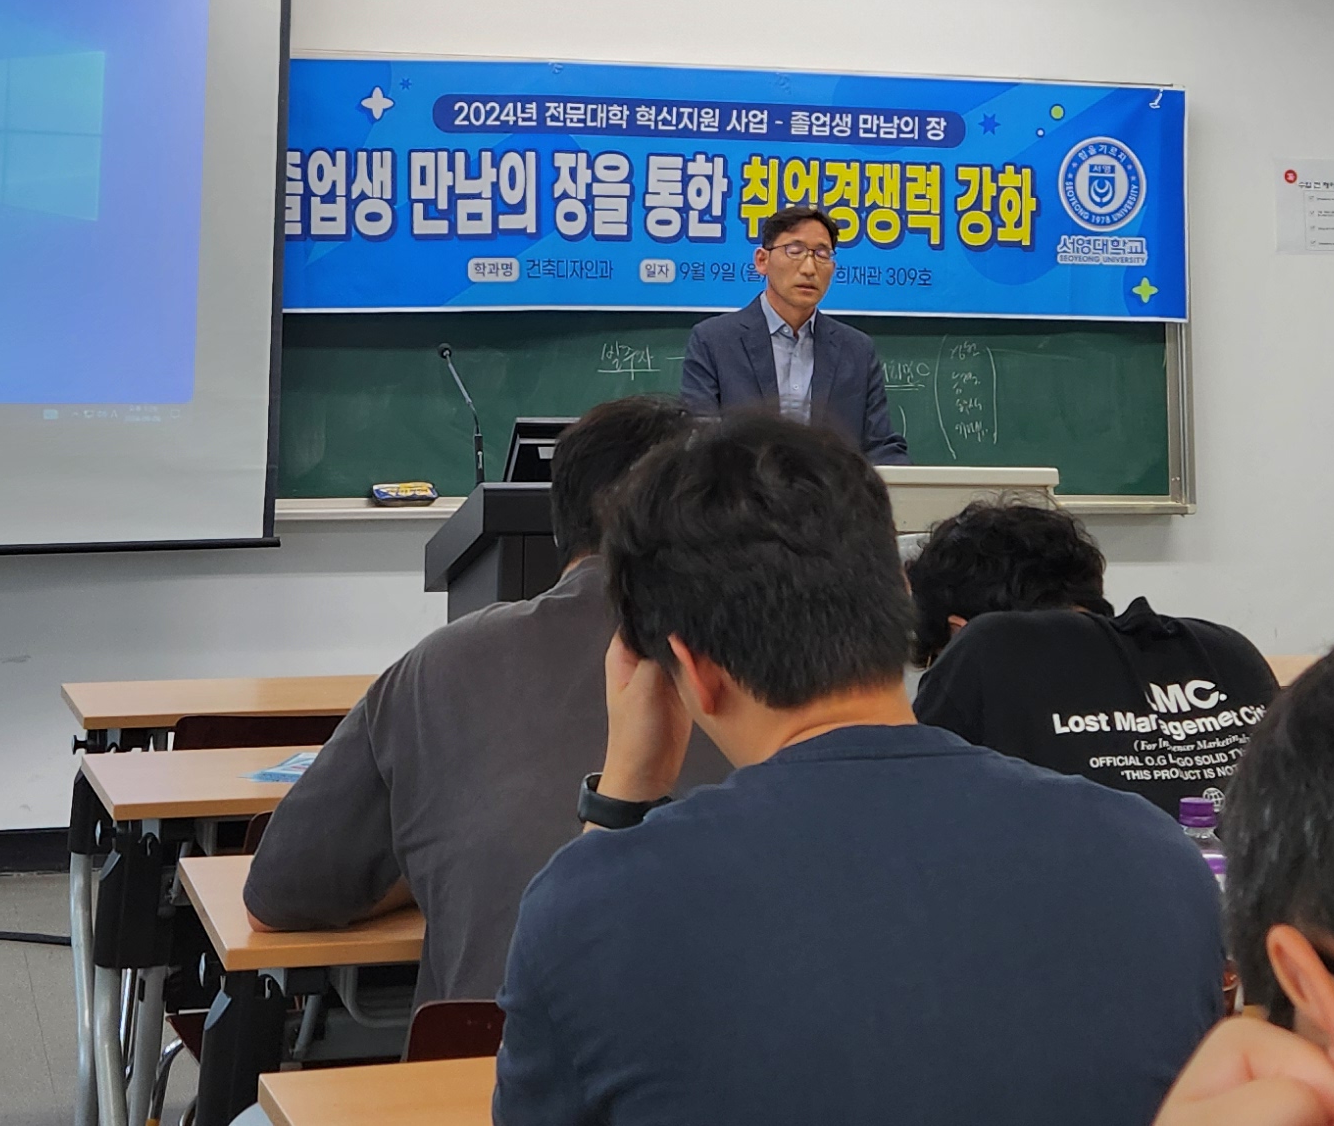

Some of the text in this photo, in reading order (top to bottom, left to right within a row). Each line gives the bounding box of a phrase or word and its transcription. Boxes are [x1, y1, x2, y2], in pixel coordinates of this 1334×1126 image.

[453, 101, 537, 126] 2024년
[544, 101, 629, 129] 전문대학
[635, 104, 720, 132] 혁신지원
[726, 108, 768, 134] 사업
[790, 110, 852, 137] 졸업생
[858, 113, 919, 140] 만남의
[925, 116, 947, 141] 장
[410, 150, 536, 235] 만남의
[553, 151, 631, 236] 장을
[644, 154, 728, 239] 통한
[957, 164, 1036, 247] 강화
[1059, 237, 1146, 255] 서영대학교
[526, 259, 614, 280] 건축디자인과
[1059, 254, 1146, 264] SEOYEONG UNIVERSITY
[473, 262, 514, 278] 학과명
[644, 262, 670, 279] 일자
[679, 260, 706, 281] 9월
[710, 262, 737, 282] 9일
[835, 265, 933, 286] 희재관 309호
[1145, 679, 1228, 714] MC.
[1052, 712, 1111, 735] Lost
[1089, 755, 1141, 769] OFFICIAL
[1144, 755, 1167, 767] O.G
[1194, 751, 1228, 767] SOLID
[1203, 767, 1216, 779] IS
